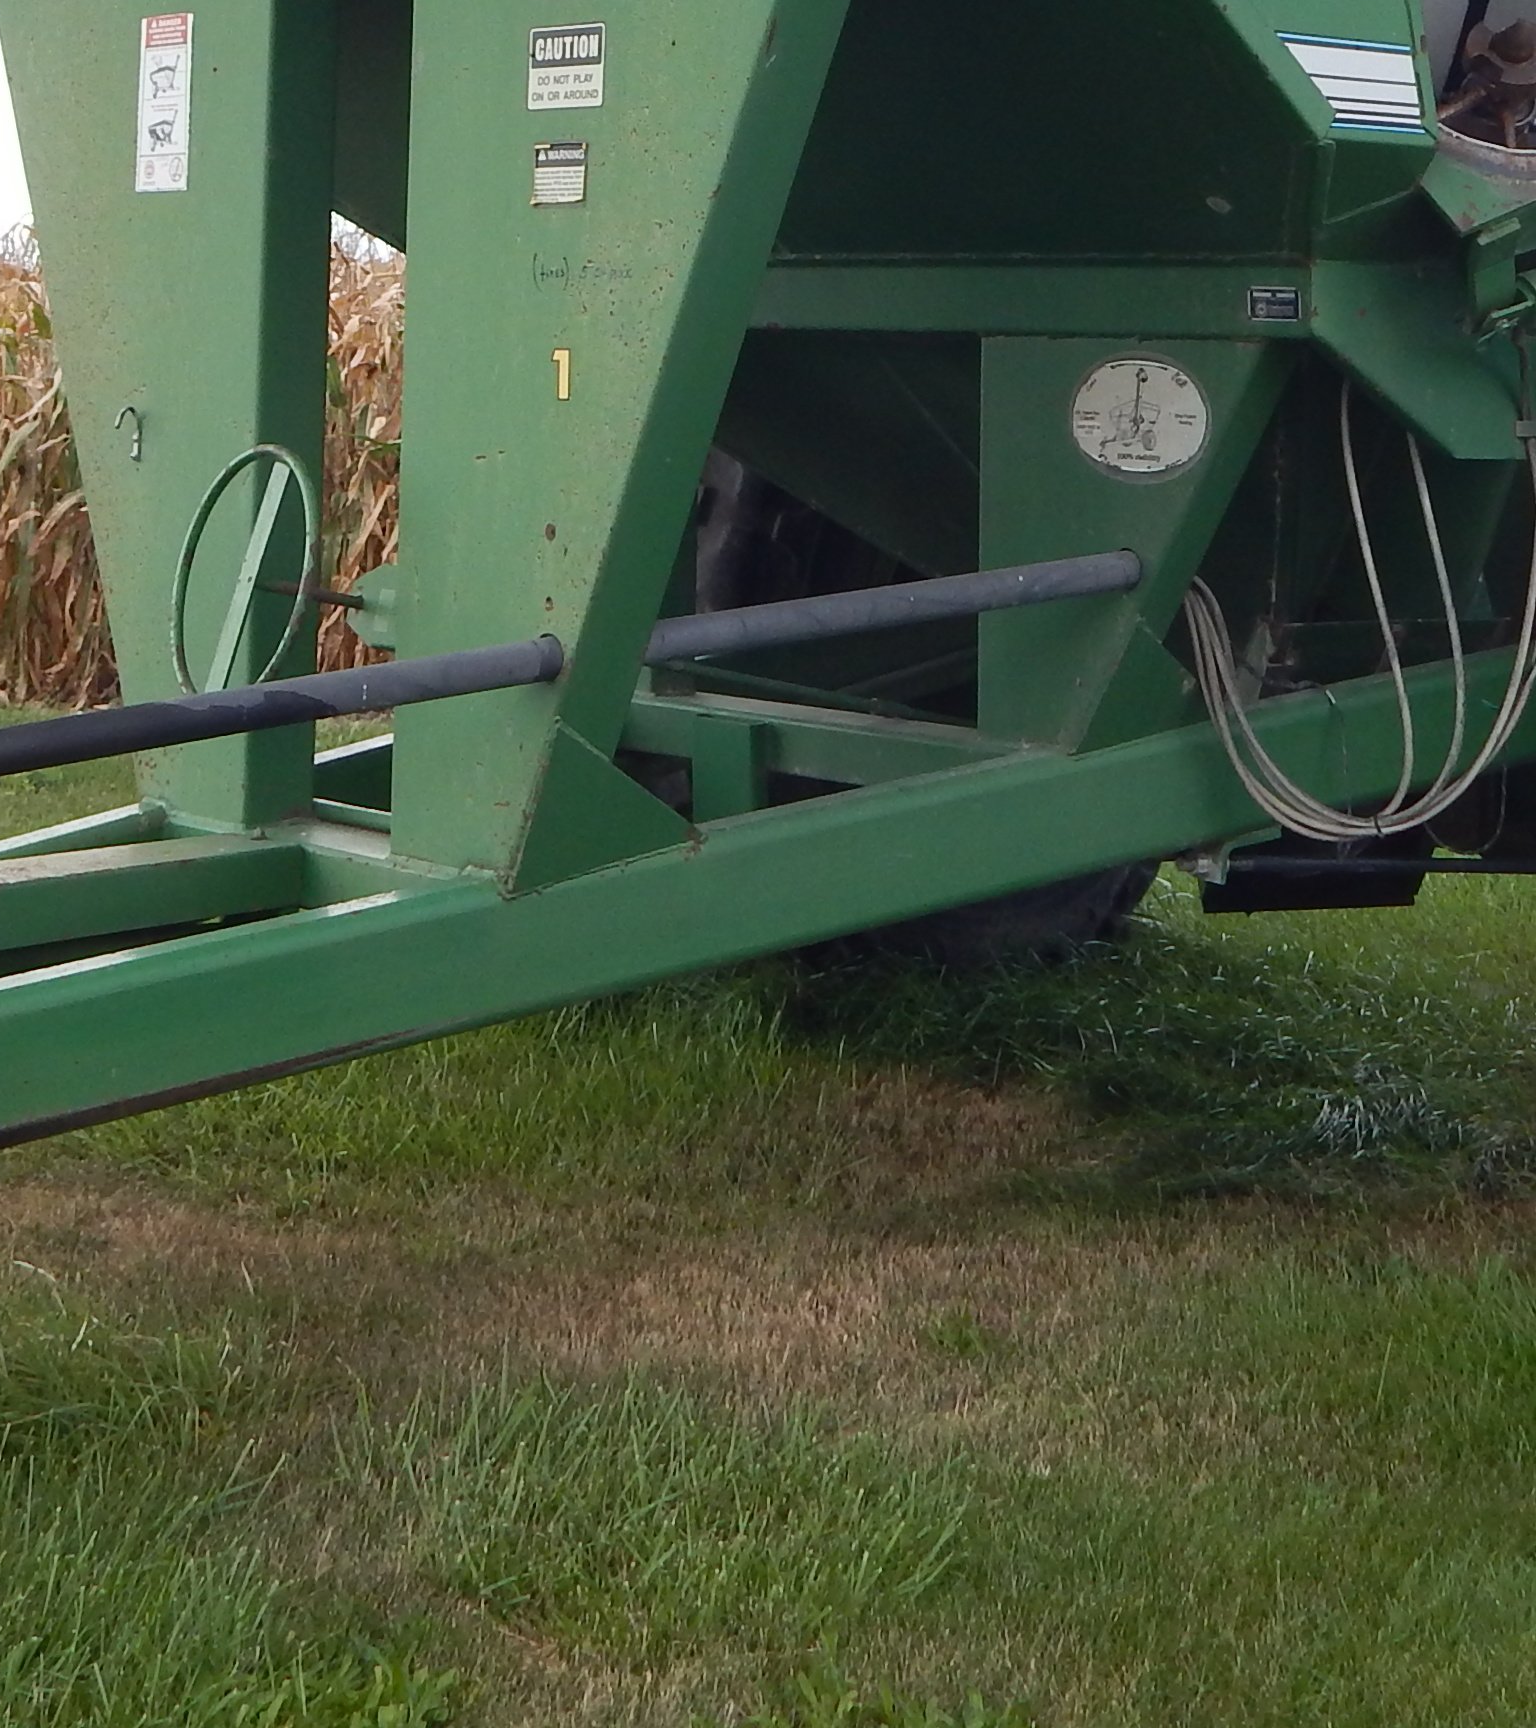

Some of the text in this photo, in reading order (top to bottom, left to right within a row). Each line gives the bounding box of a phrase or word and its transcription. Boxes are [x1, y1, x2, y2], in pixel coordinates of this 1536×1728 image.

[535, 34, 599, 61] CAUTION
[537, 73, 593, 86] DO NOT PLAY
[531, 88, 599, 102] ON OR AROUND
[551, 348, 571, 401] 1
